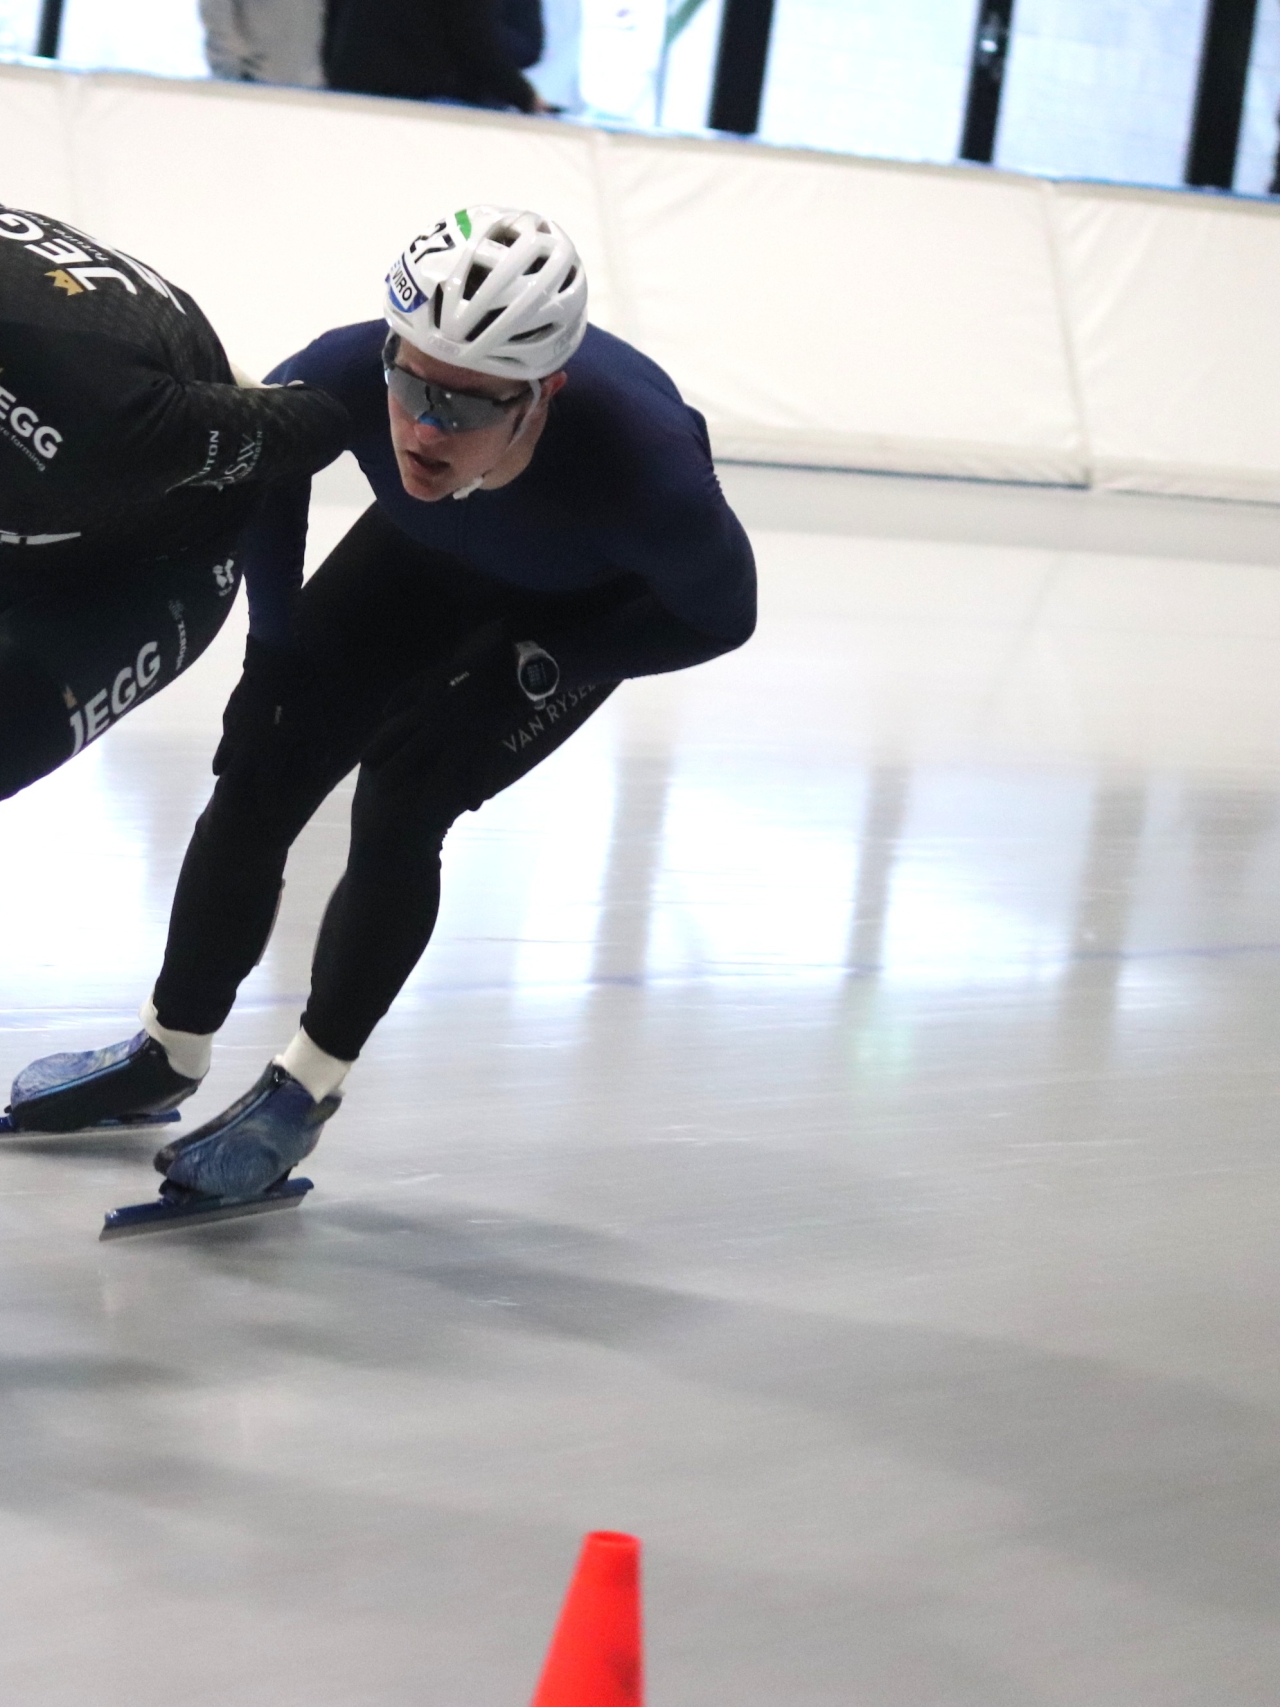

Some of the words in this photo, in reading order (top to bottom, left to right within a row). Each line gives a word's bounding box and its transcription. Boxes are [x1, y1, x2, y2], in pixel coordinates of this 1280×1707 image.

[11, 435, 46, 472] farming
[69, 641, 161, 757] JEGG
[503, 715, 545, 753] VAN
